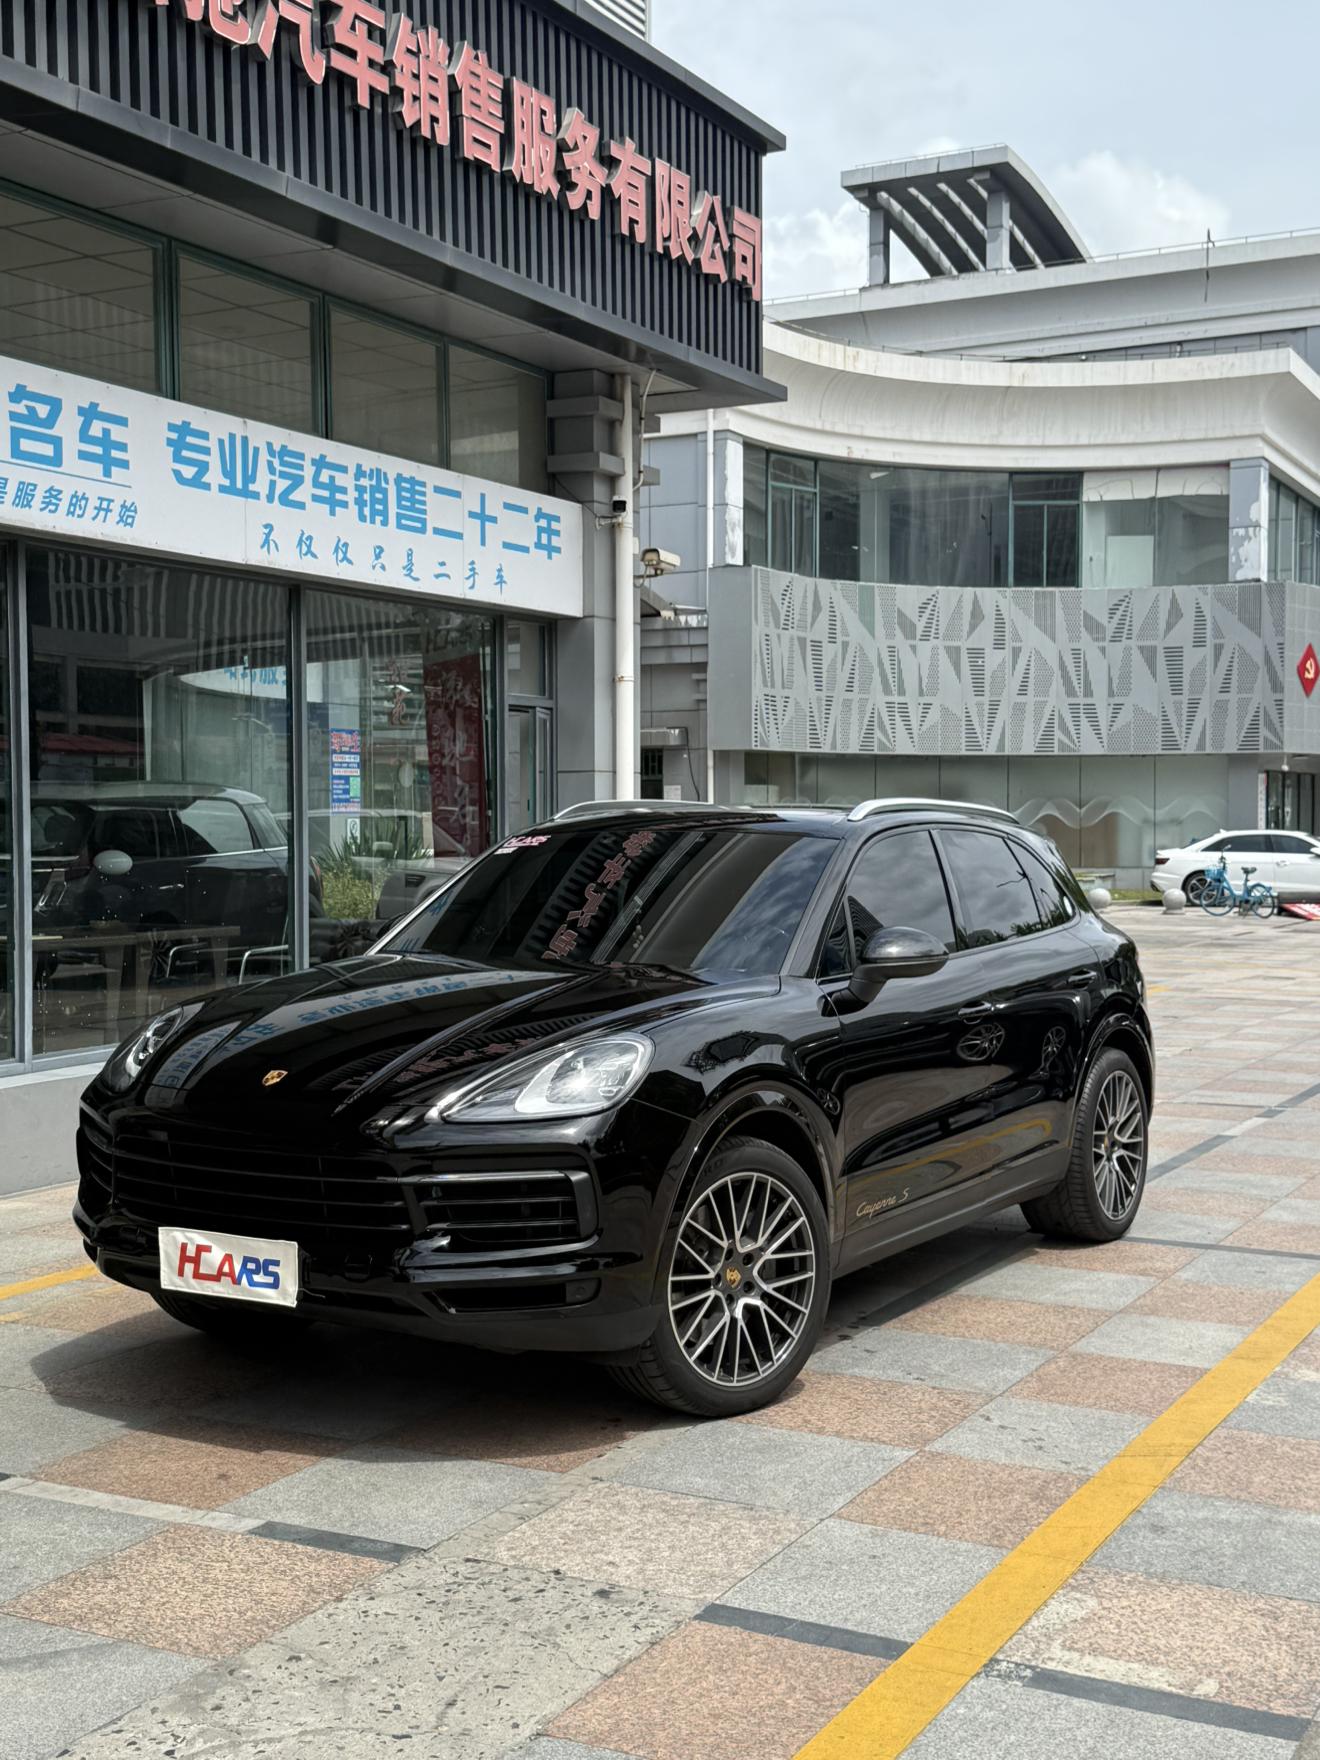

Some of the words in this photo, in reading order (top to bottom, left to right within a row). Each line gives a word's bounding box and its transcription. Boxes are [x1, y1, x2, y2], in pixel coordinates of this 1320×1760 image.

[8, 383, 130, 479] 名车
[165, 420, 562, 561] 专业汽车销售二十二年
[260, 523, 508, 595] 不仅仅只是二手车
[856, 1195, 897, 1219] Cayenne
[897, 1187, 910, 1203] S
